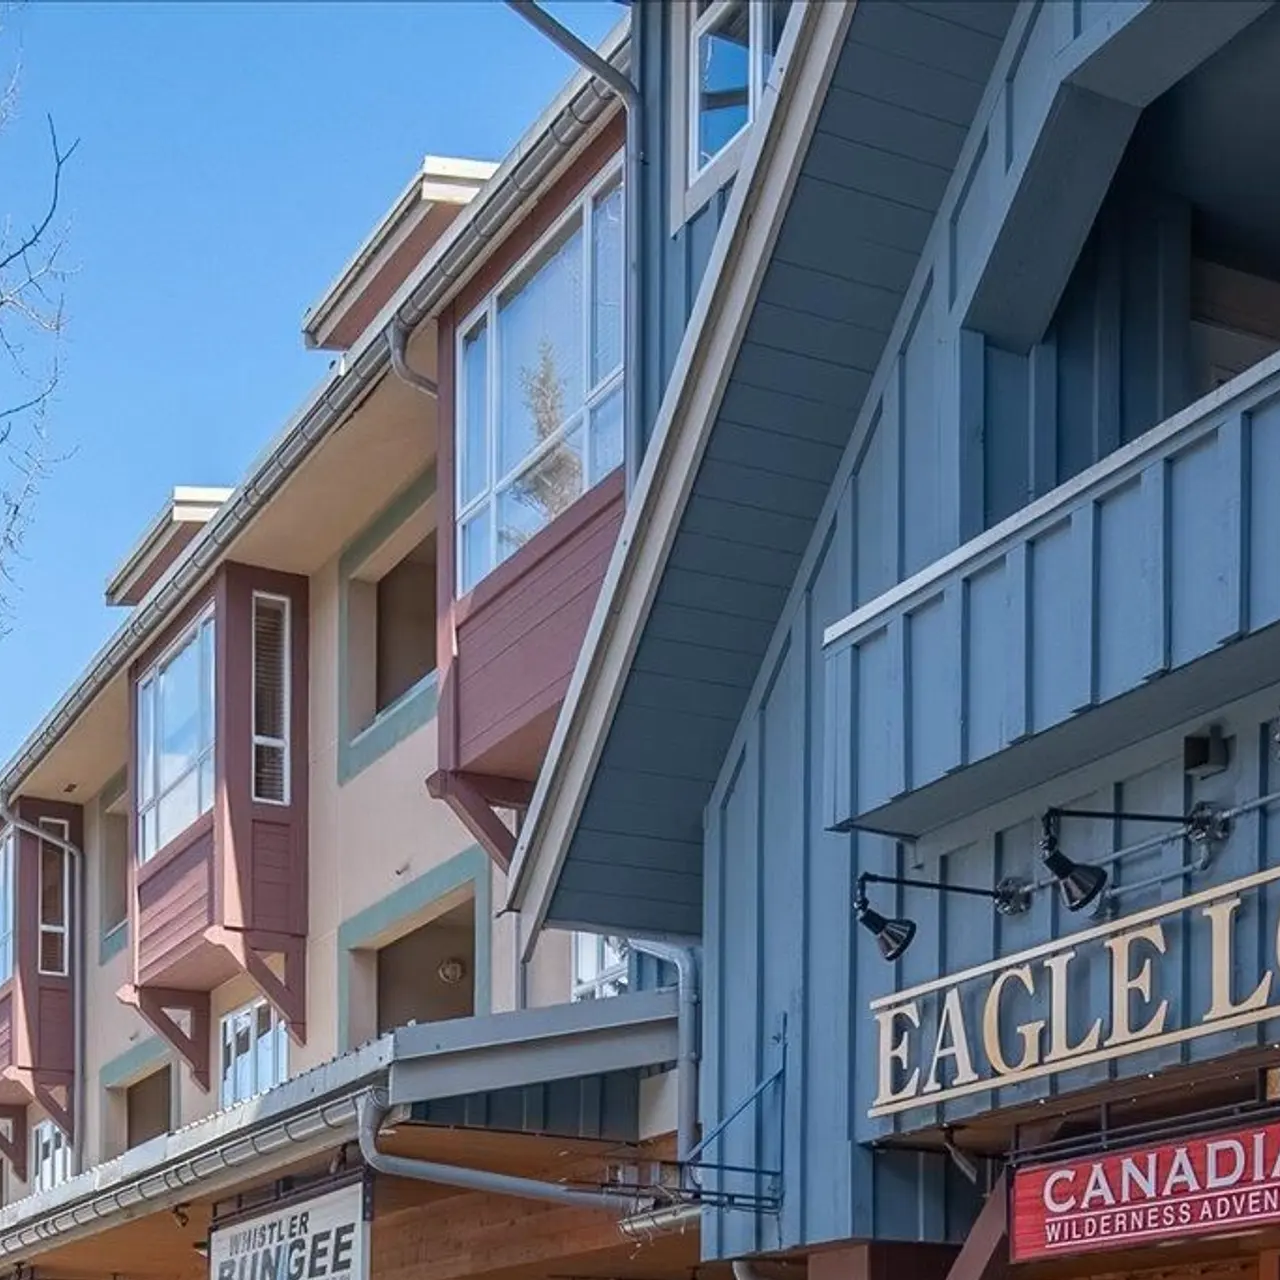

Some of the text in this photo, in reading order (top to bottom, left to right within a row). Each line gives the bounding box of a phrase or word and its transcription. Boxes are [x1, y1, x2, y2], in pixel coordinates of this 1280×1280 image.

[874, 923, 1168, 1106] EAGLE
[229, 1211, 310, 1256] WHISTLER
[1045, 1205, 1192, 1243] WILDERNESS
